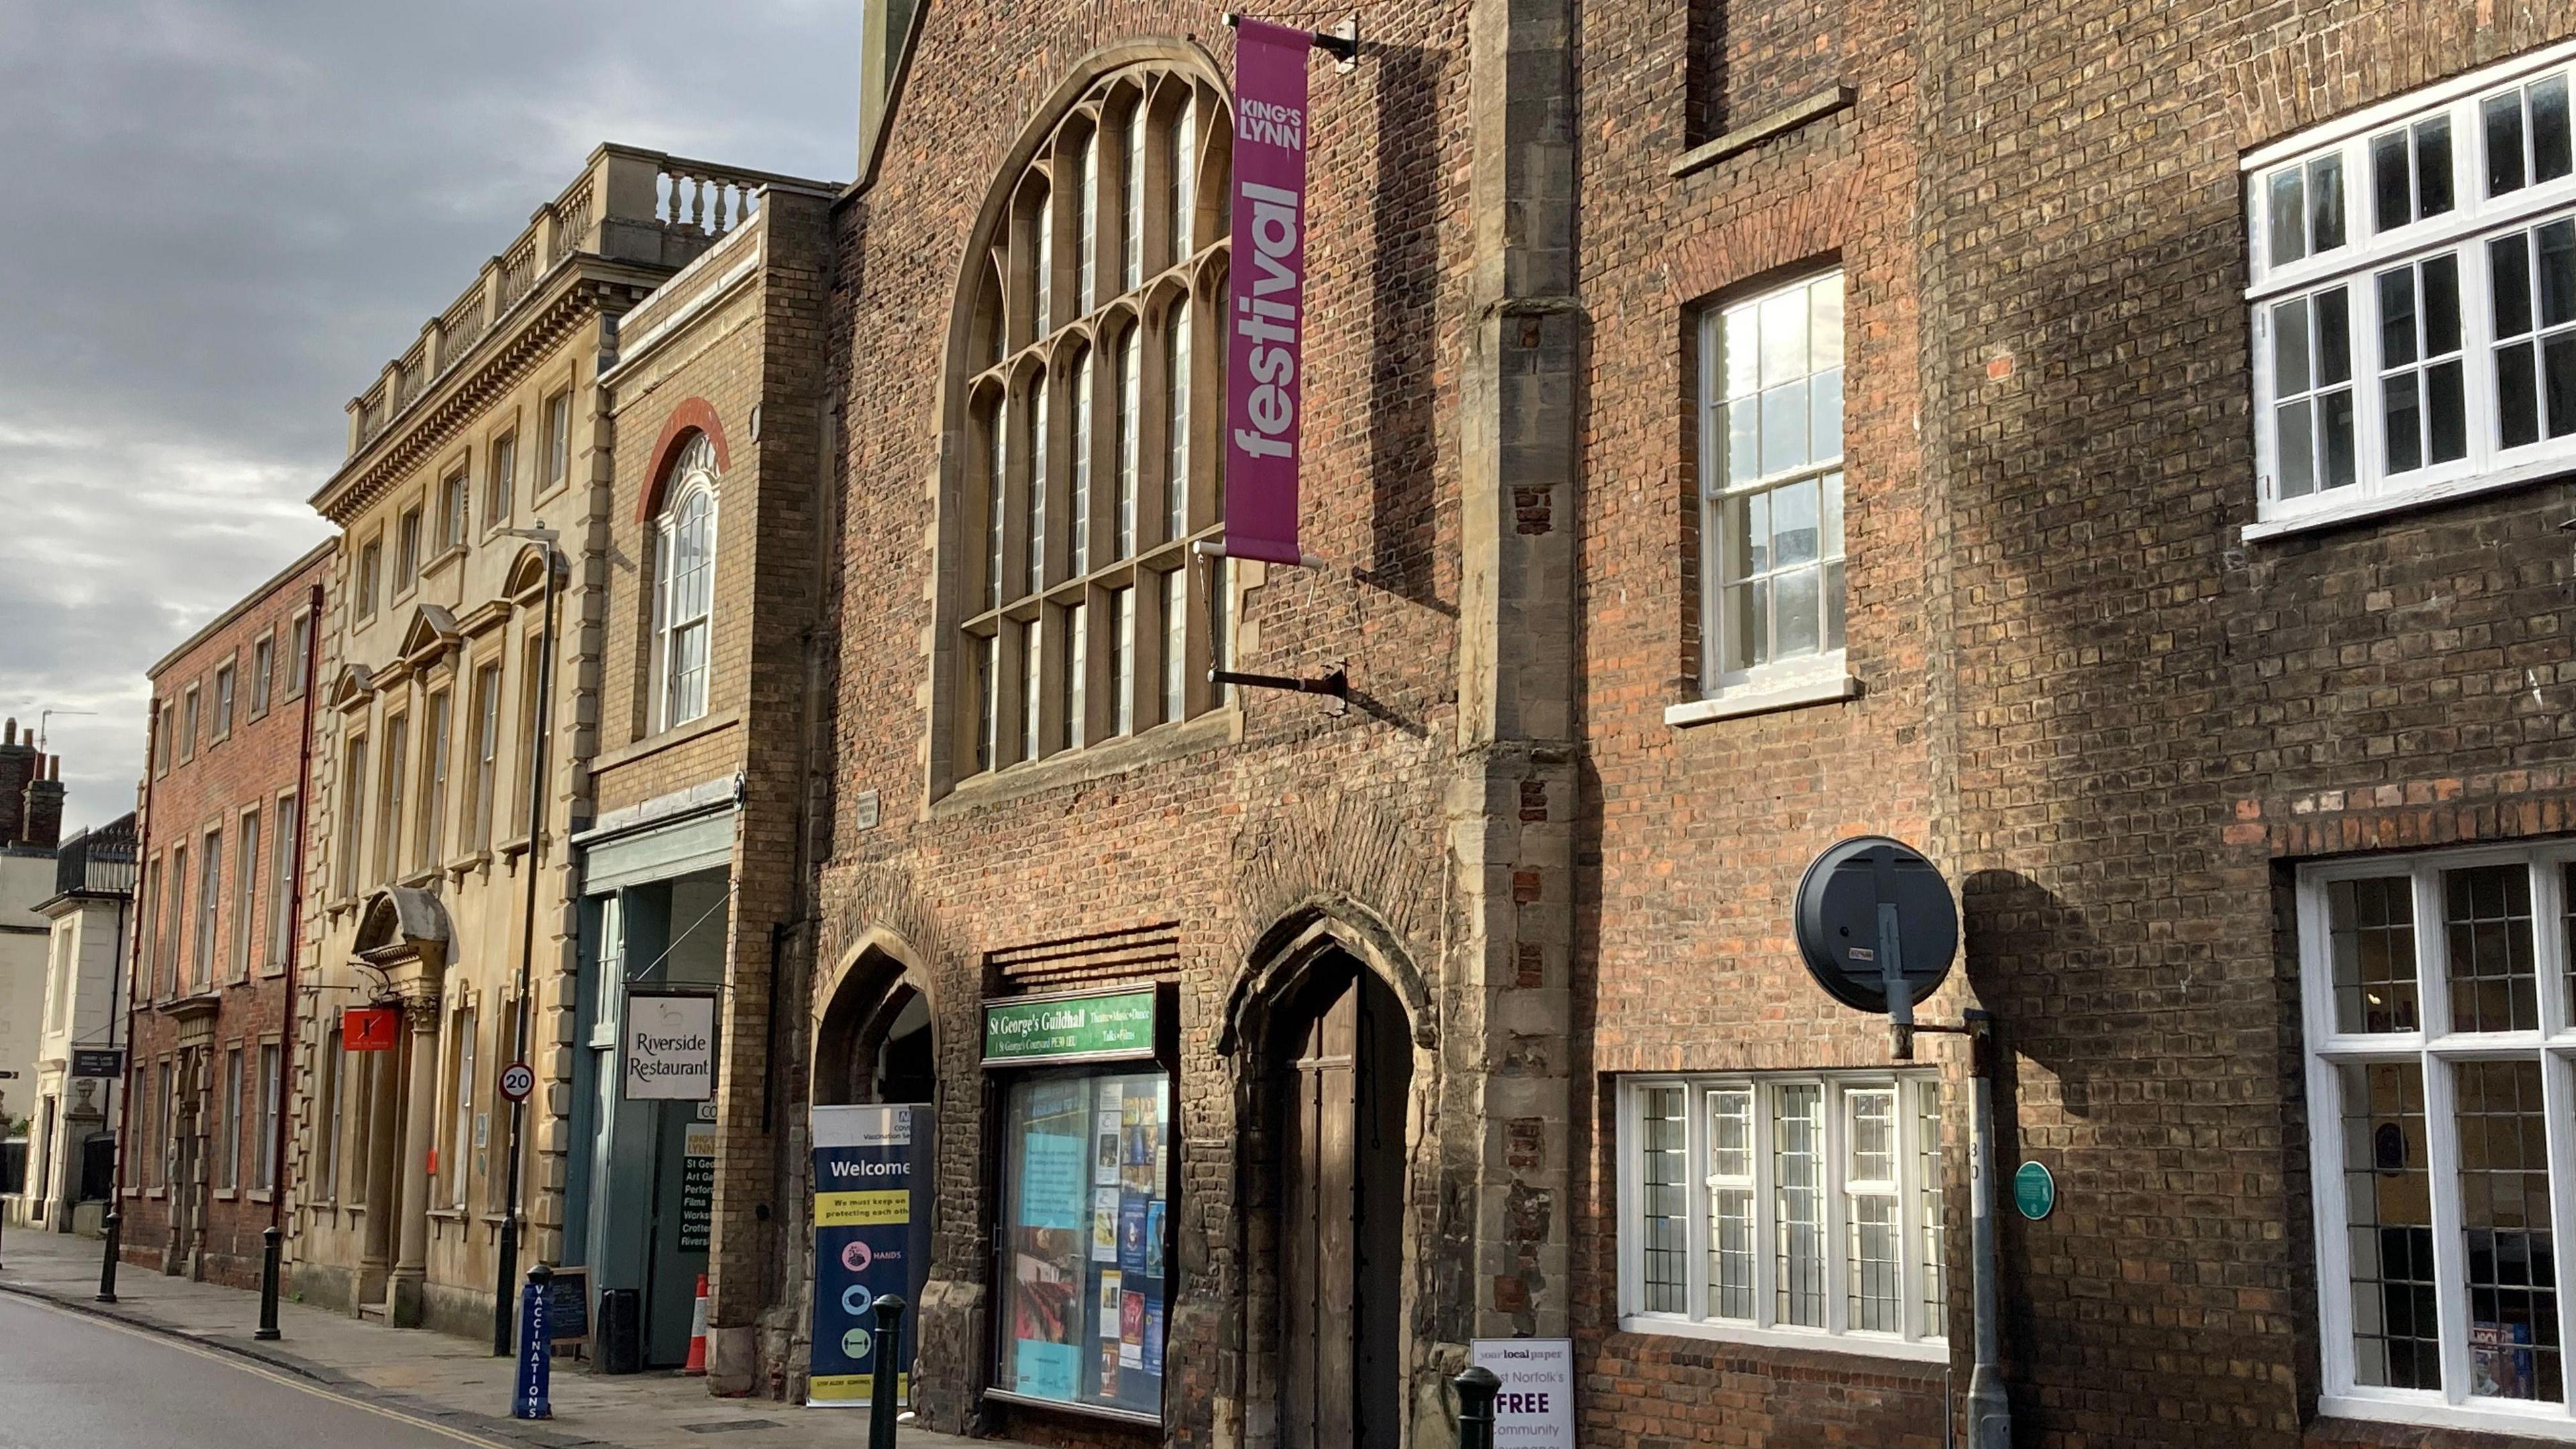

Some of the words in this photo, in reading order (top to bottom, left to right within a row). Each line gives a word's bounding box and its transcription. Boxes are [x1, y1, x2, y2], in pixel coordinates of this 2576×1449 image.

[1240, 97, 1302, 127] KING'S
[1240, 115, 1301, 152] LYNN
[1234, 180, 1298, 459] festival
[989, 1017, 999, 1036] St
[1001, 1013, 1039, 1036] George's
[1041, 1008, 1085, 1031] Guildhall
[636, 1032, 706, 1057] Riverside
[630, 1057, 710, 1083] Restaurant
[506, 1073, 529, 1089] 20
[686, 1171, 700, 1181] Art
[830, 1159, 911, 1177] Welcome
[684, 1197, 706, 1206] Films
[826, 1210, 870, 1219] protecting
[873, 1251, 902, 1259] HANDS
[529, 1285, 544, 1418] VACCINATIONS
[1503, 1349, 1529, 1358] local
[1513, 1371, 1564, 1383] Norfolk's
[1496, 1393, 1550, 1413] FREE
[1494, 1424, 1560, 1438] ommunity
